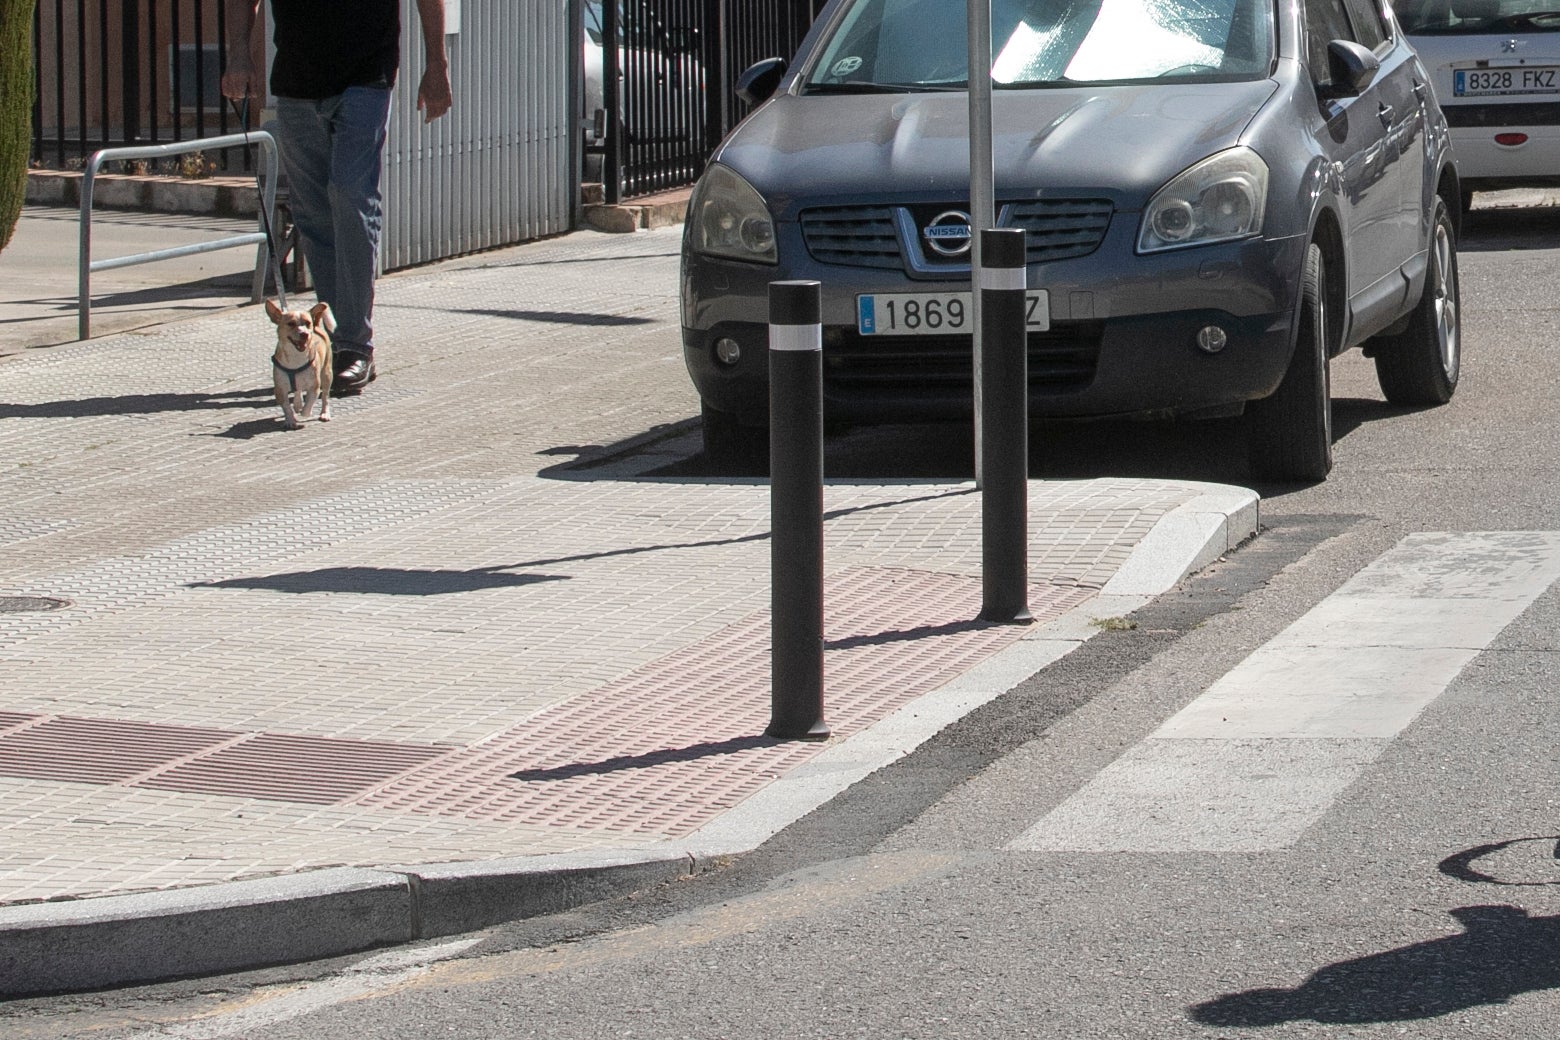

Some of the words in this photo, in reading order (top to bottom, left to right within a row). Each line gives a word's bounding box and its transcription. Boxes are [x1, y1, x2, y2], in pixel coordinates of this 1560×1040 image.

[1469, 72, 1512, 90] 8328
[1523, 70, 1556, 88] FKZ
[864, 318, 872, 328] E
[886, 298, 965, 330] 1869
